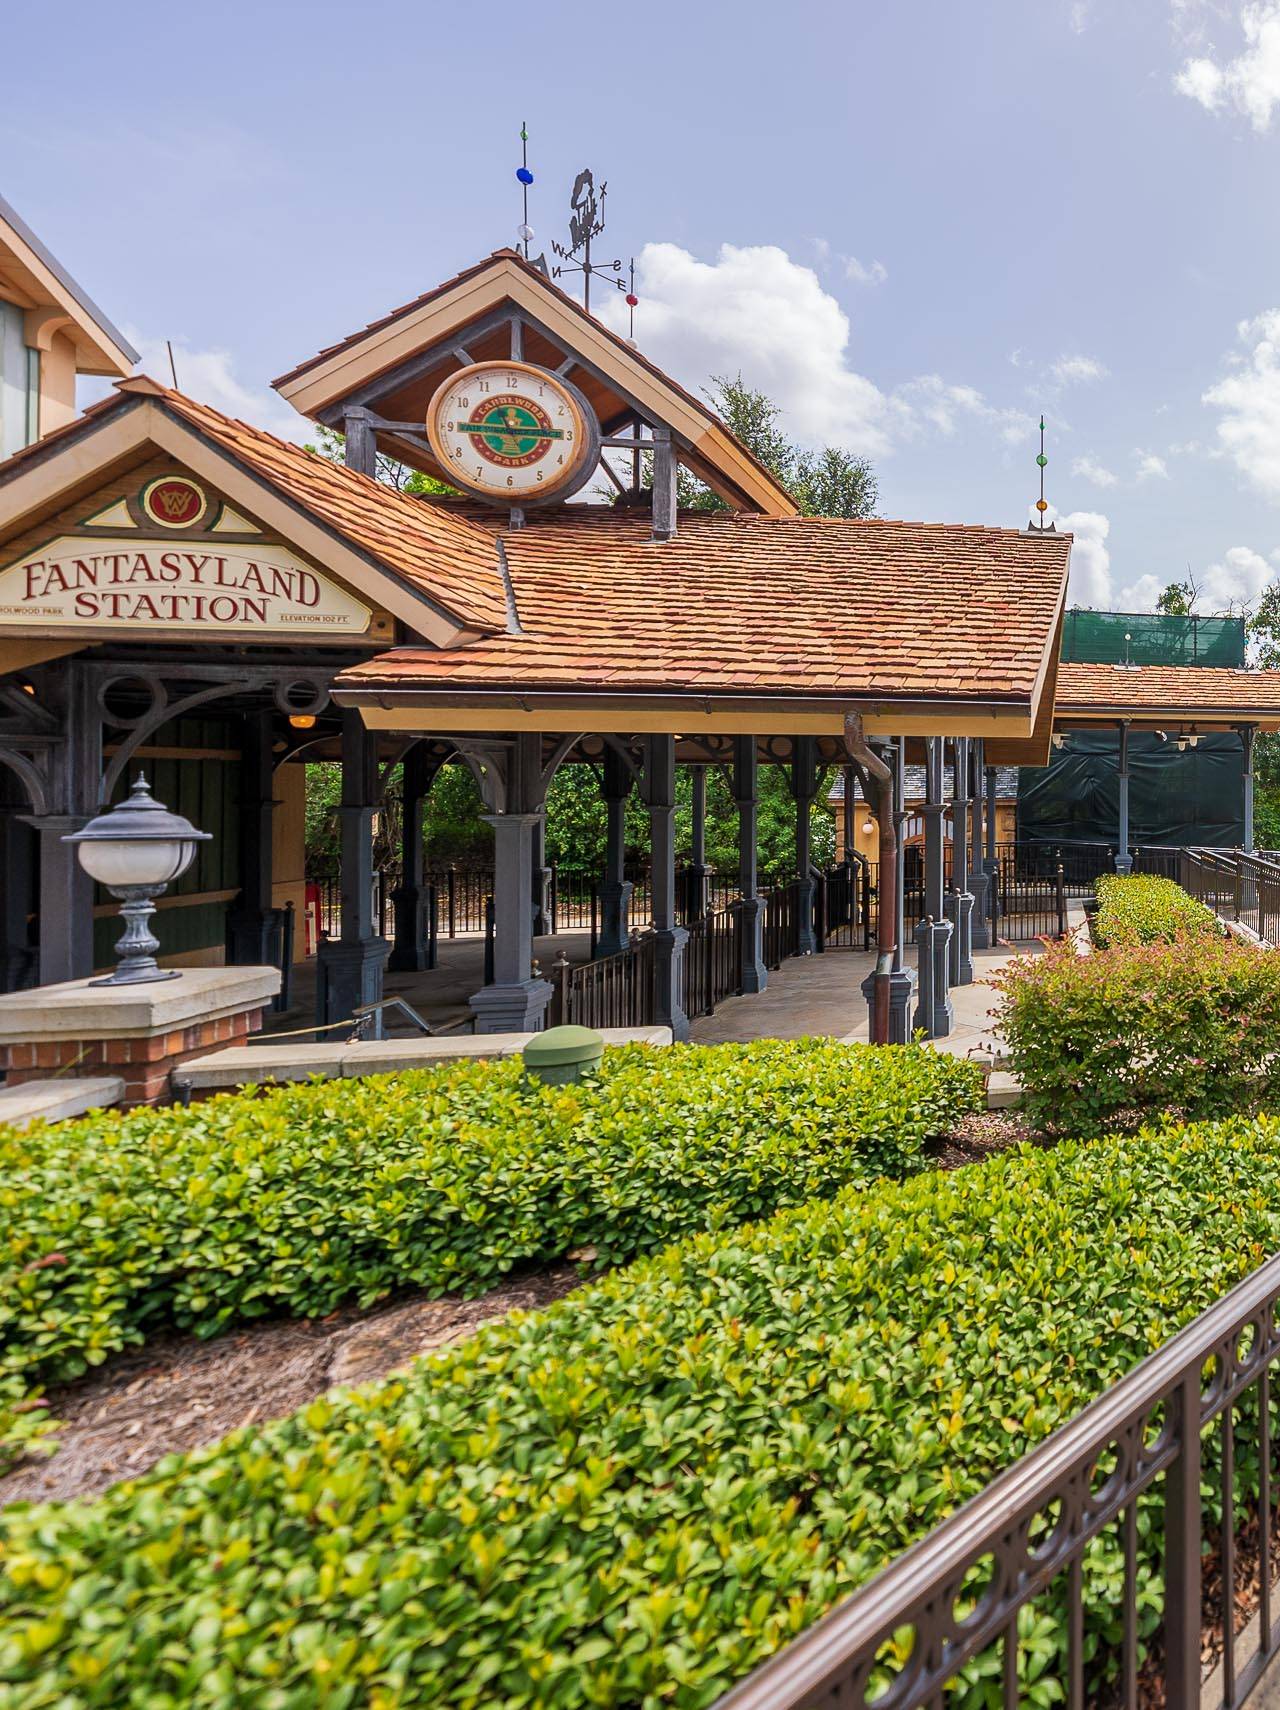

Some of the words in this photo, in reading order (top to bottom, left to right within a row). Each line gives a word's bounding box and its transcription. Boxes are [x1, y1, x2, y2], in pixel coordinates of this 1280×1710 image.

[478, 381, 490, 393] 11
[506, 377, 518, 388] 12
[538, 386, 544, 397] 1
[457, 397, 469, 408] 10
[557, 406, 565, 416] 2
[447, 421, 454, 432] 9
[566, 430, 573, 441] 3
[455, 447, 463, 458] 8
[492, 455, 529, 466] PARK
[556, 454, 563, 465] 4
[476, 466, 483, 477] 7
[536, 470, 543, 481] 5
[506, 475, 513, 486] 6
[22, 553, 320, 607] FANTASYLAND
[42, 607, 63, 615] PARK
[74, 592, 272, 623] STATION
